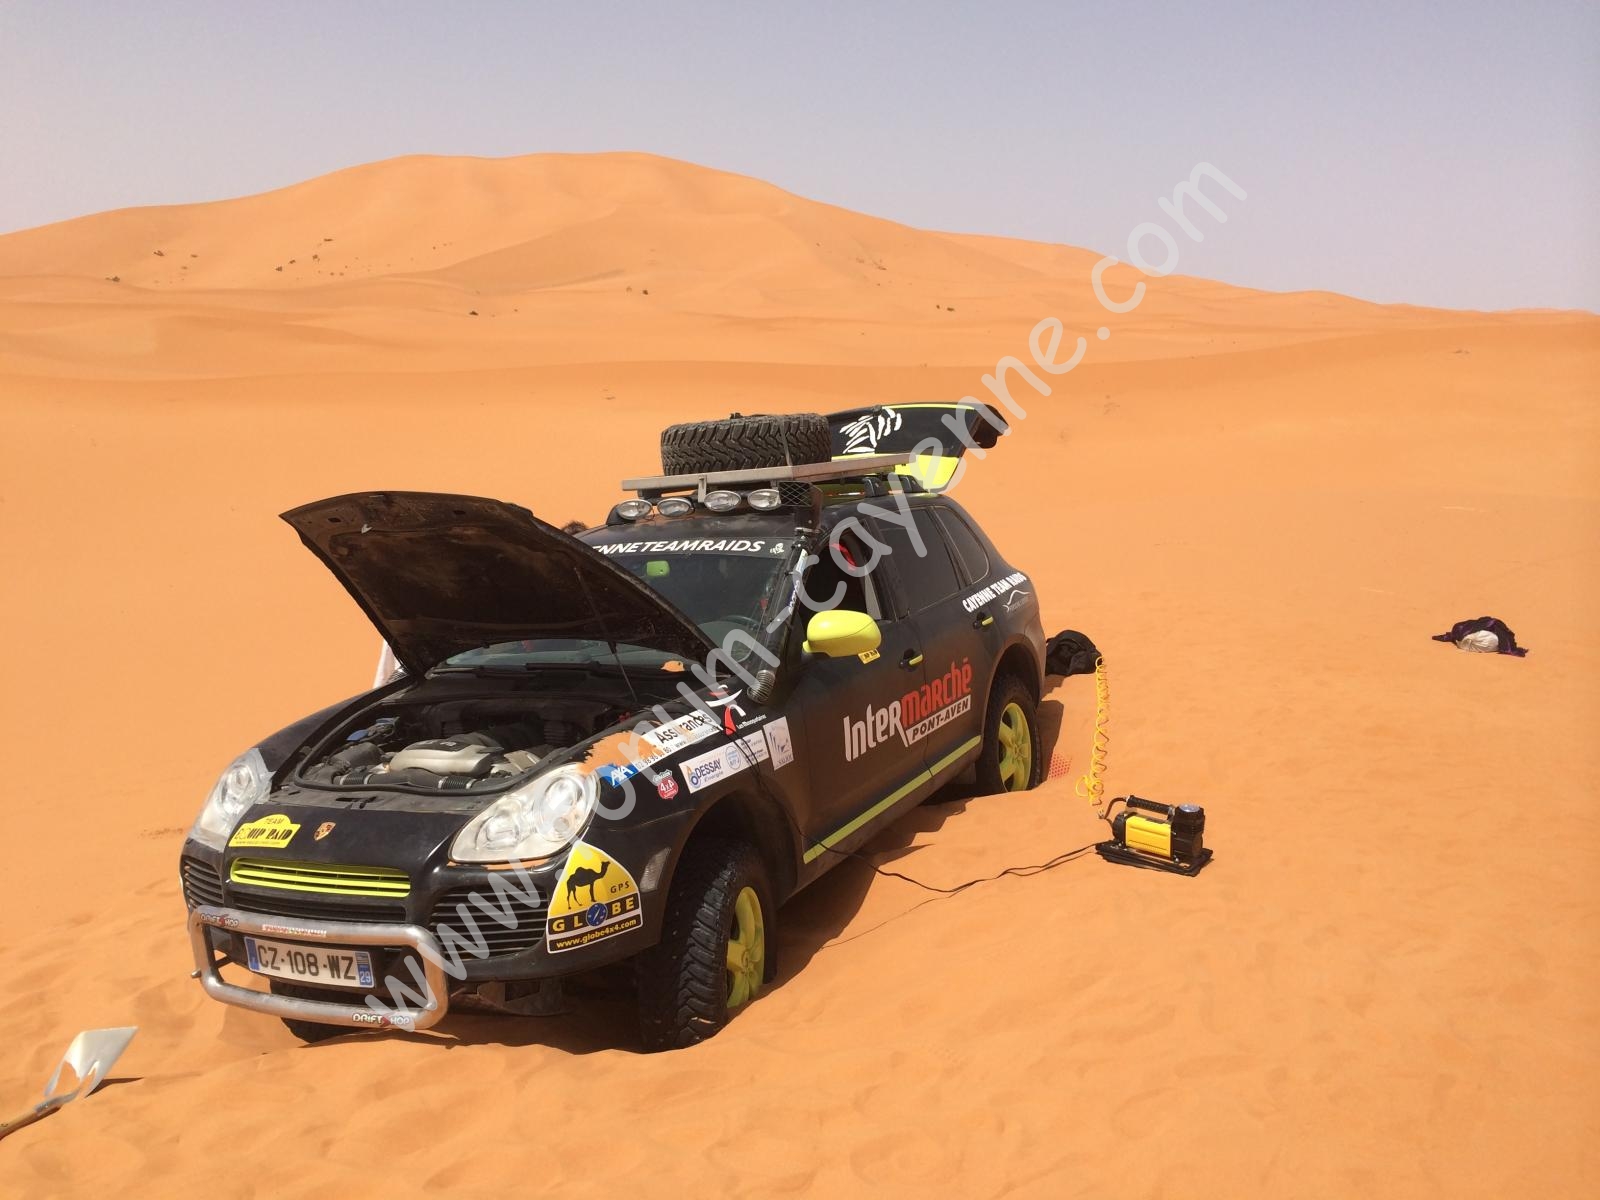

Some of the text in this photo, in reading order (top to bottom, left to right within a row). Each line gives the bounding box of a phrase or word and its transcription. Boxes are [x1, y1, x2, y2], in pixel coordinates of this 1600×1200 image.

[962, 586, 997, 613] CAYENNE
[990, 578, 1013, 596] TEAM
[911, 698, 970, 742] PONT-AVEN
[610, 764, 634, 787] AXA
[694, 758, 721, 779] DESSAY
[610, 880, 631, 895] GPS
[556, 919, 637, 949] www.globe4x4.com
[360, 970, 371, 984] 29
